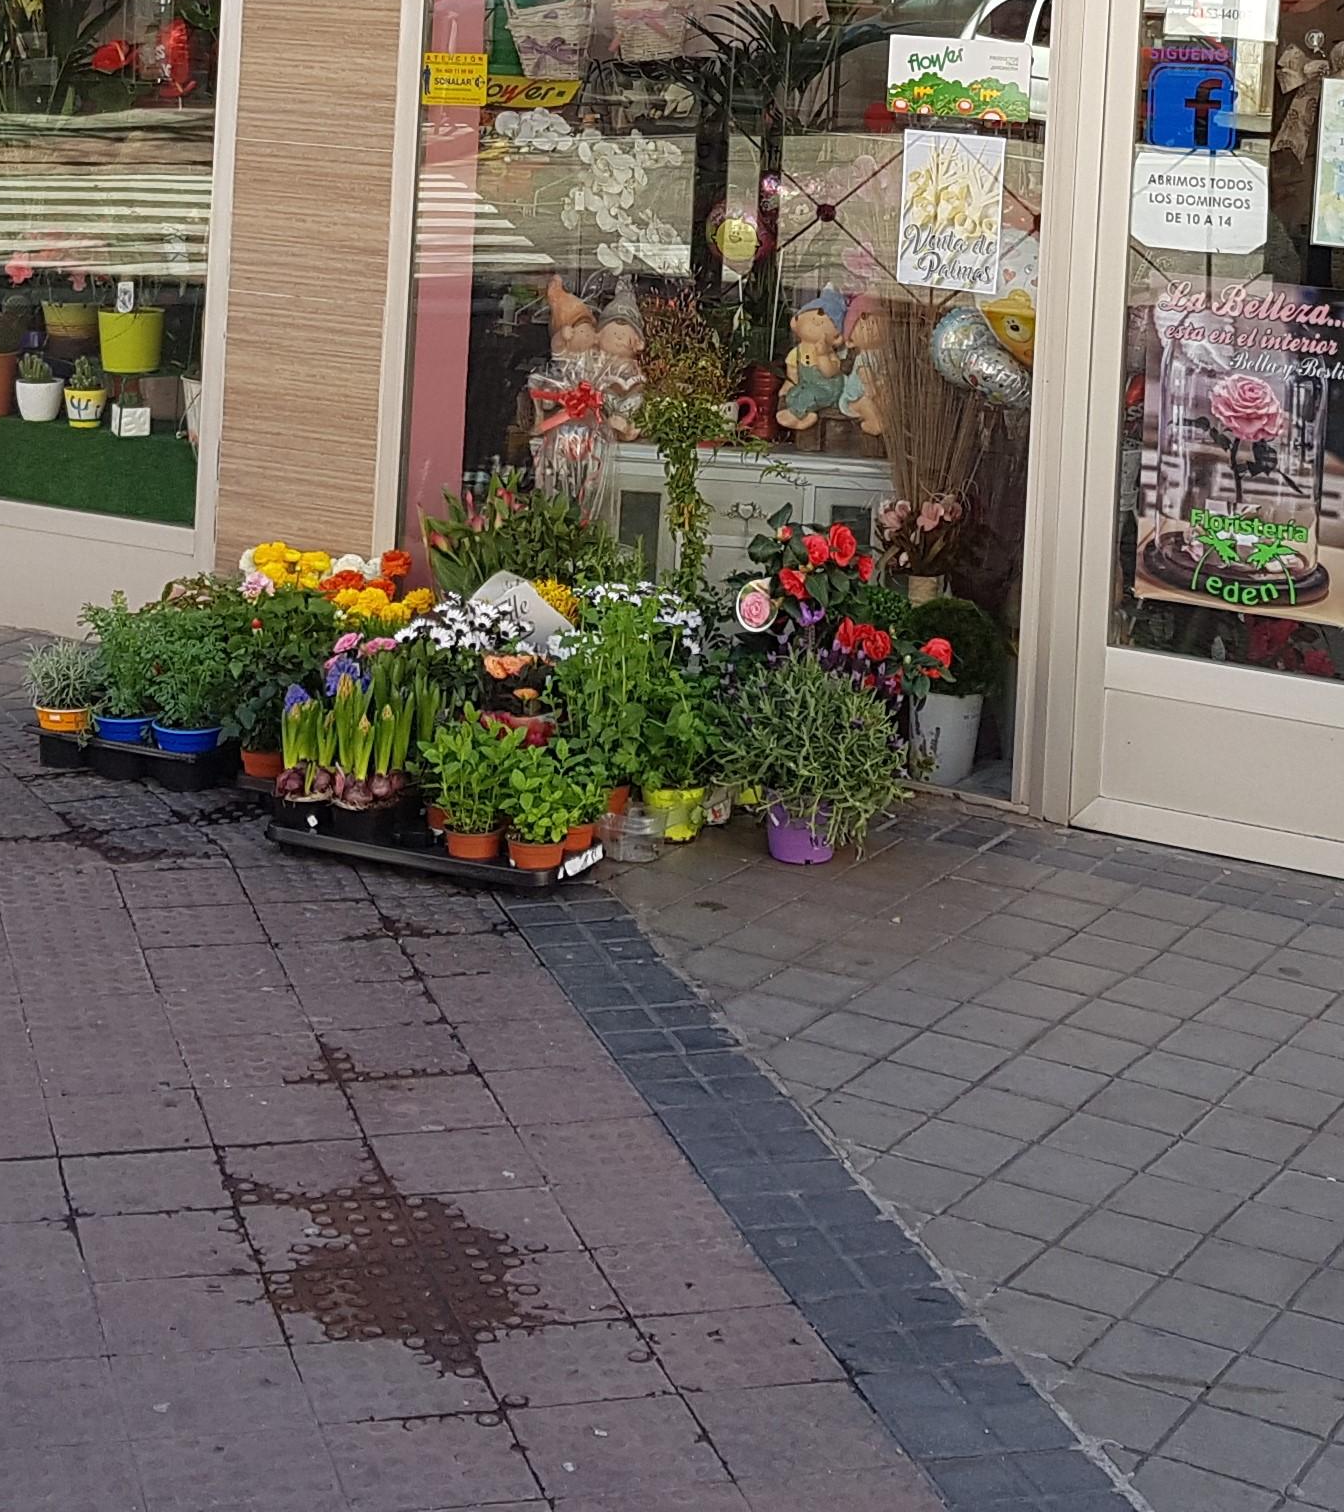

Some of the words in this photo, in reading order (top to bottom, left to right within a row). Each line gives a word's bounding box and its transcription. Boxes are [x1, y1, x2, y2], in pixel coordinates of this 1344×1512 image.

[907, 45, 964, 72] flower
[1147, 173, 1206, 189] ABRIMOS
[1209, 176, 1254, 192] TODOS
[1148, 192, 1172, 205] LOS
[1175, 193, 1251, 210] DOMINGOS
[1165, 211, 1182, 224] DE
[1186, 213, 1201, 226] 10
[1203, 214, 1213, 226] A
[1217, 215, 1232, 228] 14
[917, 251, 994, 285] Palmas
[1158, 279, 1204, 313] La
[1207, 328, 1233, 345] en
[1236, 327, 1257, 347] el
[1260, 329, 1340, 356] interior
[1228, 350, 1282, 375] Bella
[1190, 507, 1310, 544] Floristería
[1205, 572, 1280, 607] eden
